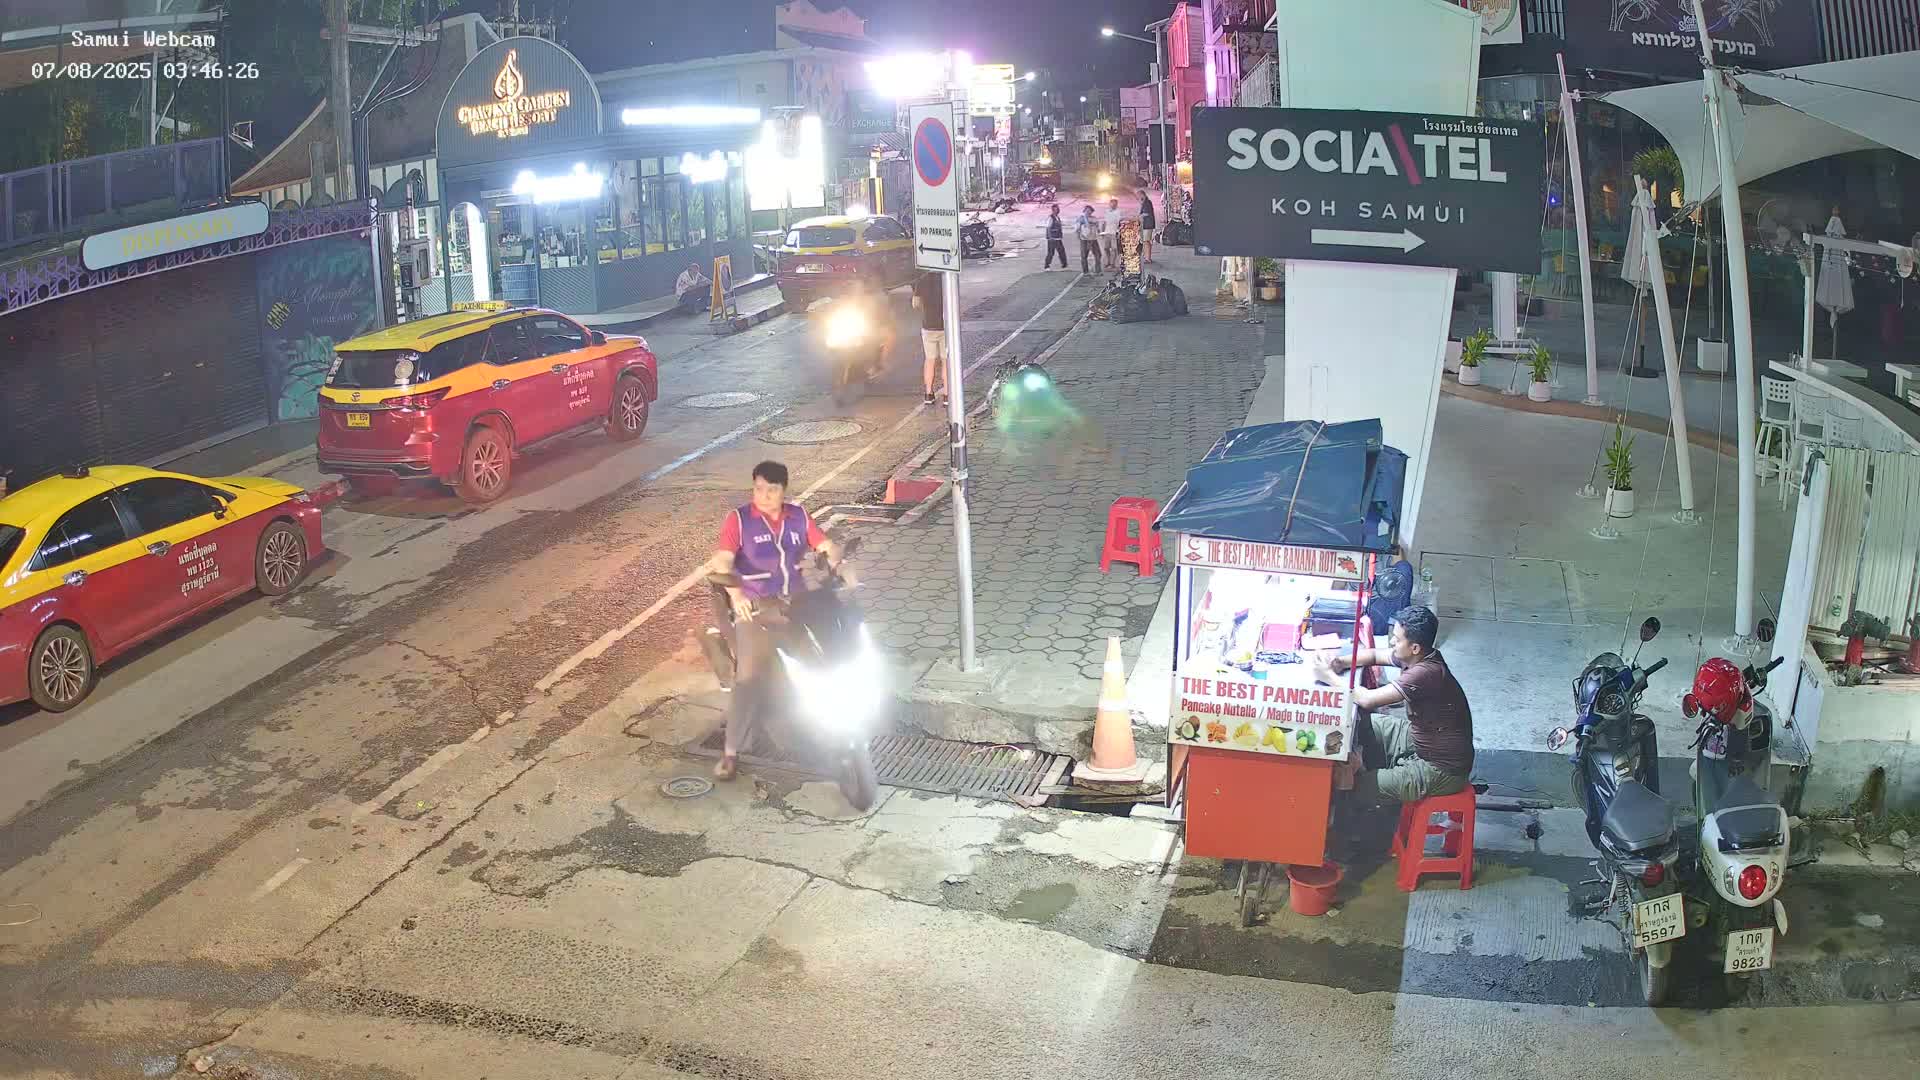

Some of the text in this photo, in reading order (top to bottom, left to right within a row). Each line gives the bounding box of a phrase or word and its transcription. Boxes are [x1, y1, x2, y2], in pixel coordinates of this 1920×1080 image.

[1422, 117, 1518, 137] โรงแรมโซเชียลเทล
[1271, 197, 1465, 224] KOH SAMUI
[122, 204, 236, 257] DISPENSARY
[920, 227, 953, 237] NO PARKING
[198, 557, 215, 572] 1123
[1207, 540, 1338, 574] THE BEST PANCAKE BANANA ROTI
[1181, 677, 1344, 709] THE BEST PANCAKE
[1181, 699, 1221, 715] Pancake
[1223, 703, 1257, 718] Nutella
[1267, 708, 1292, 722] Made
[1295, 711, 1305, 722] to
[1307, 711, 1341, 727] Orders
[1641, 925, 1676, 943] 5597
[1732, 957, 1764, 970] 9823
